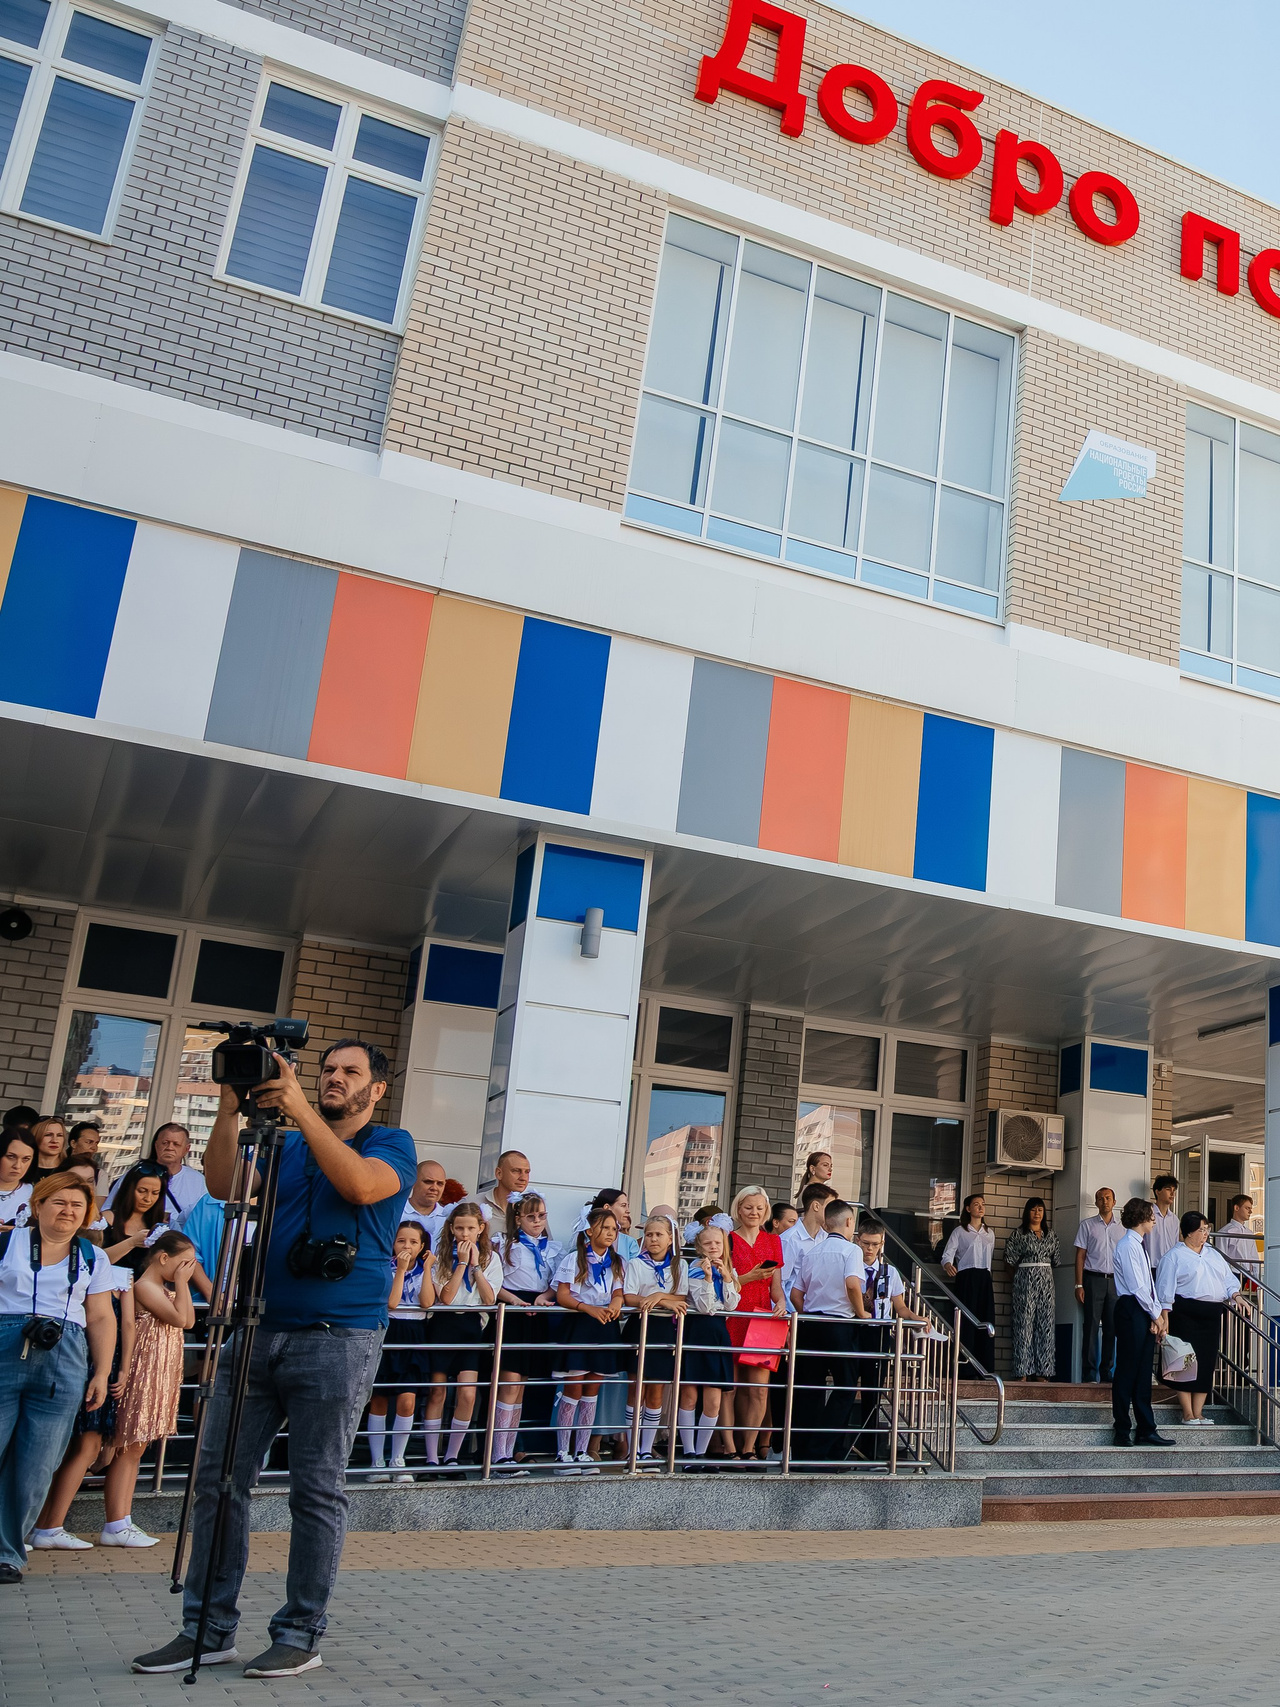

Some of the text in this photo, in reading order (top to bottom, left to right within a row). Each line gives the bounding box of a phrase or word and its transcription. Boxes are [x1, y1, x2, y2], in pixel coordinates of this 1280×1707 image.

[694, 0, 1140, 247] Добро
[1099, 440, 1149, 462] ОБРАЗОВАНИЕ
[1089, 449, 1147, 477] НАЦИОНАЛЬНЫЕ
[1113, 467, 1147, 487] ПРОЕКТЫ
[1118, 480, 1146, 496] РОССИИ
